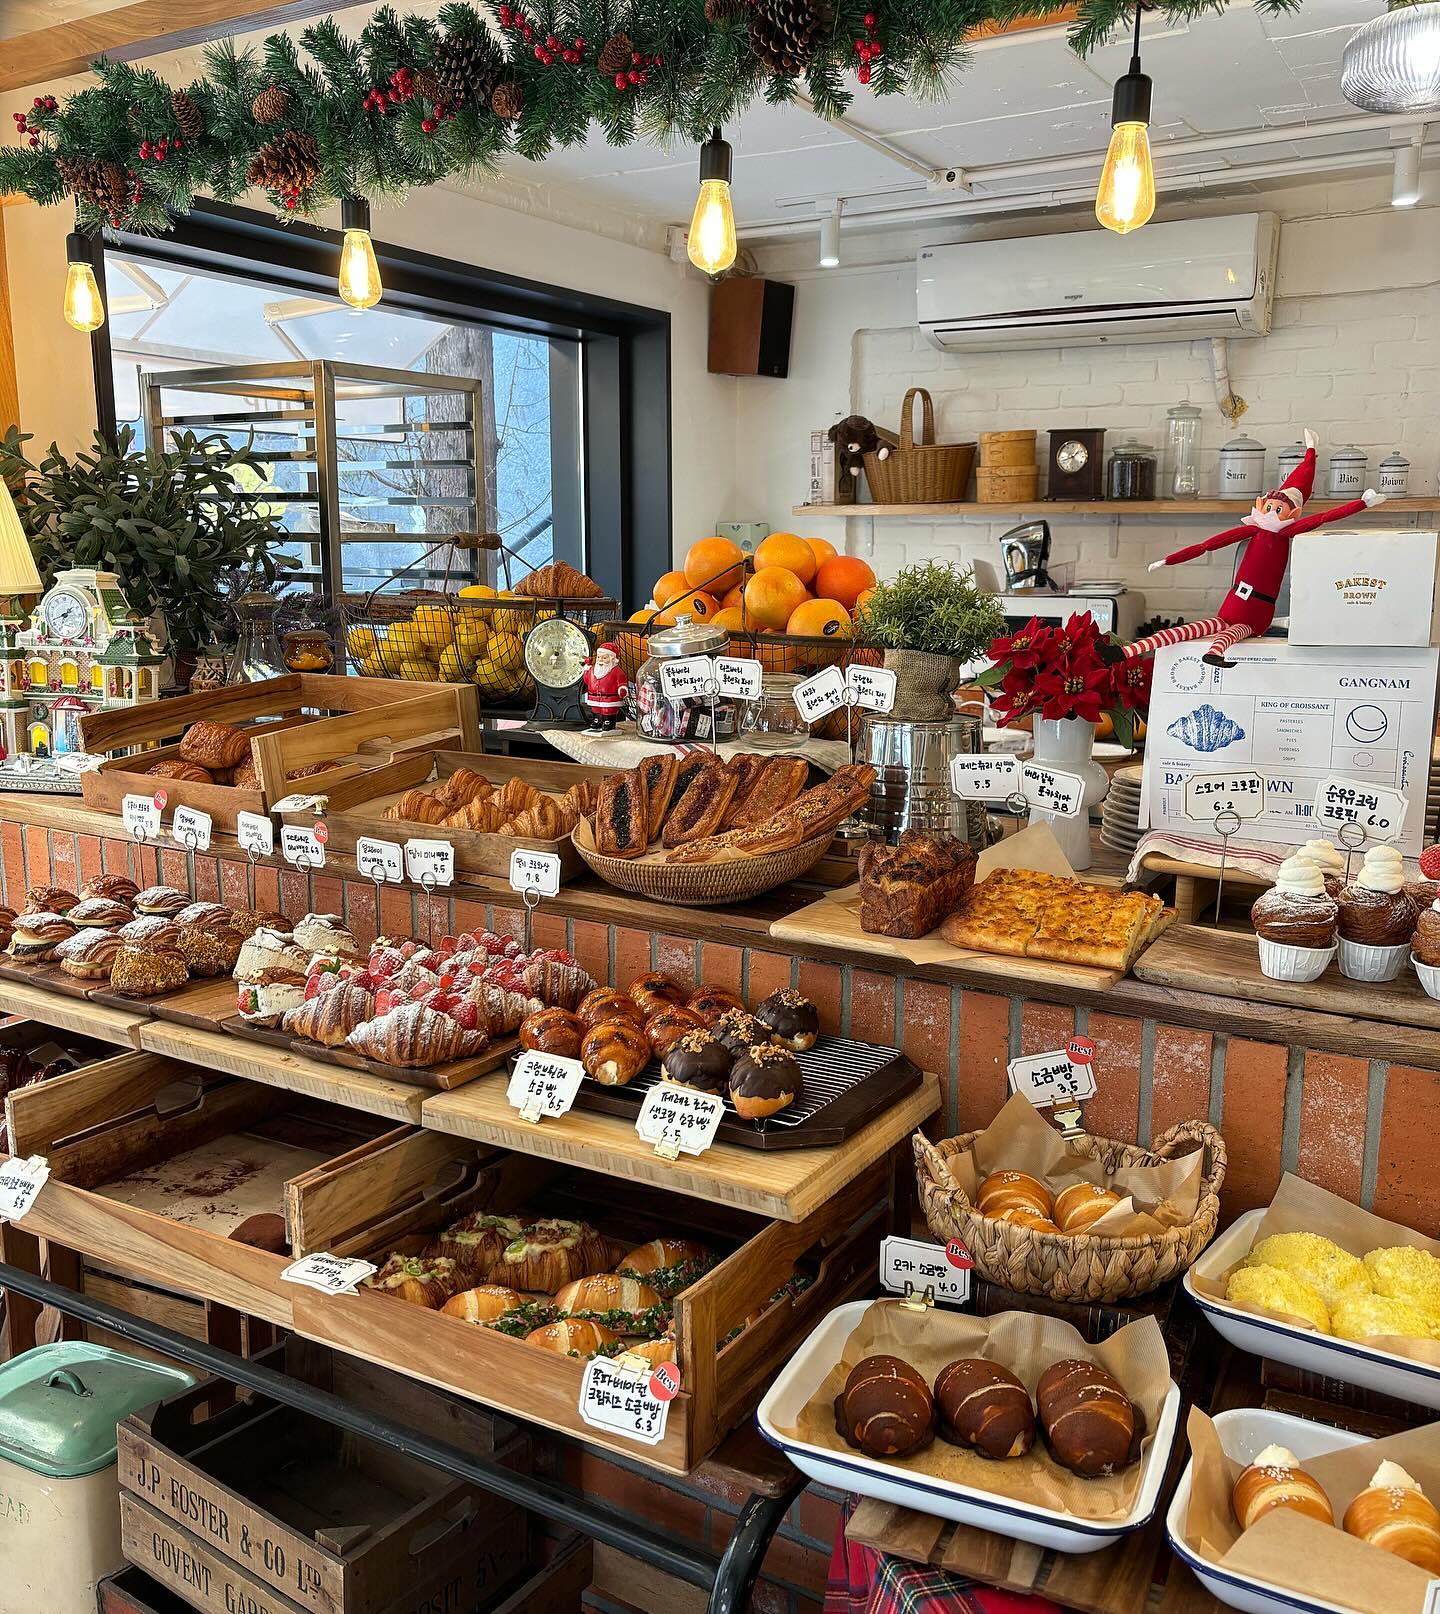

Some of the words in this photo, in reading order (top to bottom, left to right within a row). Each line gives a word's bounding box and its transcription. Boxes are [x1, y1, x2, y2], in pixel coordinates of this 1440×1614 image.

[1226, 469, 1247, 480] Sucre
[1338, 473, 1359, 484] Pâtes
[1381, 476, 1405, 486] Poivre
[1335, 577, 1387, 590] BAKEST
[1338, 677, 1411, 689] GANGNAM
[1290, 702, 1330, 710] CROISSANT
[995, 761, 1016, 773] 식빵
[974, 779, 991, 789] 5.5
[1195, 781, 1225, 795] 스모어
[1230, 779, 1260, 793] 크로핀
[1038, 786, 1072, 802] 포카치아
[1053, 801, 1069, 812] 3.8
[1213, 801, 1235, 811] 6.2
[1323, 805, 1359, 823] 크로핀
[1367, 814, 1390, 829] 6.0
[408, 847, 423, 859] 딸기
[433, 864, 446, 873] 5.5
[526, 872, 540, 883] 7.8
[1069, 1042, 1093, 1057] Best
[1031, 1062, 1075, 1087] 소금빵
[1057, 1080, 1079, 1094] 3.5
[548, 1095, 565, 1111] 6.5
[661, 1091, 690, 1106] 페레로
[679, 1113, 711, 1131] 소금빵
[892, 1258, 916, 1271] 모카
[919, 1262, 948, 1278] 소금빵
[938, 1282, 958, 1292] 4.0
[592, 1367, 648, 1398] 쪽파베이컨
[655, 1368, 678, 1393] Best
[588, 1387, 622, 1409] 크림치즈
[624, 1397, 661, 1420] 소금빵
[635, 1417, 652, 1431] 6.3
[169, 1476, 230, 1545] FOSTER
[240, 1523, 253, 1560] &
[263, 1538, 286, 1578] CO
[152, 1532, 212, 1597] COVENT
